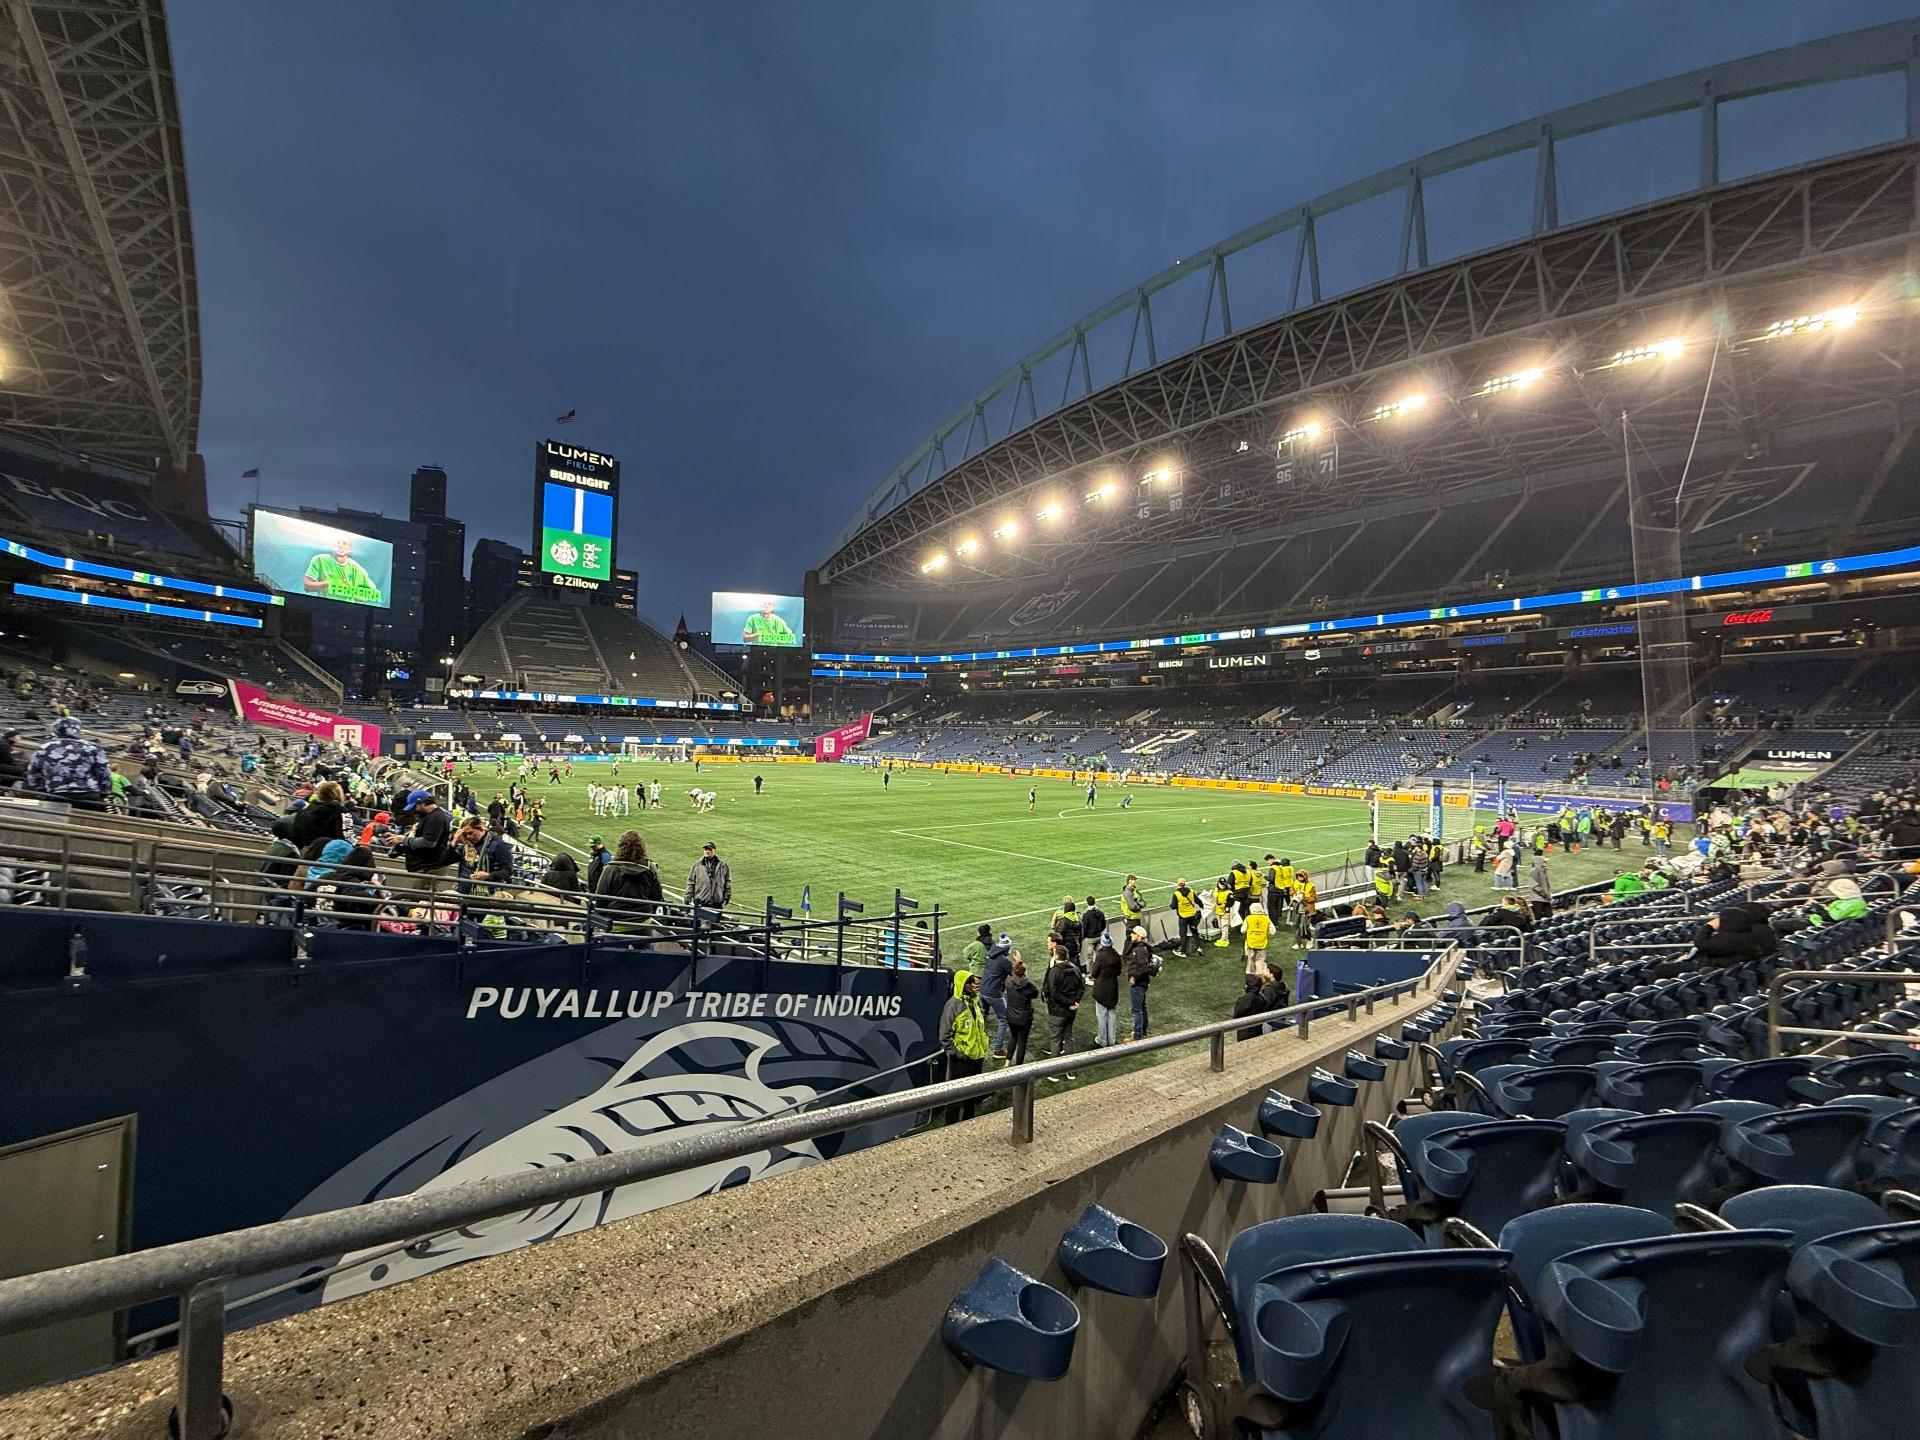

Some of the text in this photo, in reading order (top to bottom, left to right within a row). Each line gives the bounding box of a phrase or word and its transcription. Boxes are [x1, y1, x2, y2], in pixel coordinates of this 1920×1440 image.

[547, 443, 613, 467] LUMEN
[566, 459, 596, 472] FIELD
[550, 469, 611, 490] BUD LIGHT
[565, 576, 599, 590] Zillow
[330, 584, 382, 602] FERREIRA
[1570, 625, 1636, 638] ticketmaster
[1375, 642, 1417, 653] DELTA
[1463, 636, 1507, 646] BUD LIGHT
[1305, 650, 1320, 658] aws
[1209, 655, 1266, 668] LUMEN
[248, 698, 333, 724] America's Best
[285, 713, 320, 727] Network
[1767, 750, 1832, 760] LUMEN
[1443, 796, 1459, 804] CAT
[466, 987, 902, 1019] PUYALLUP TRIBE OF INDIANS
